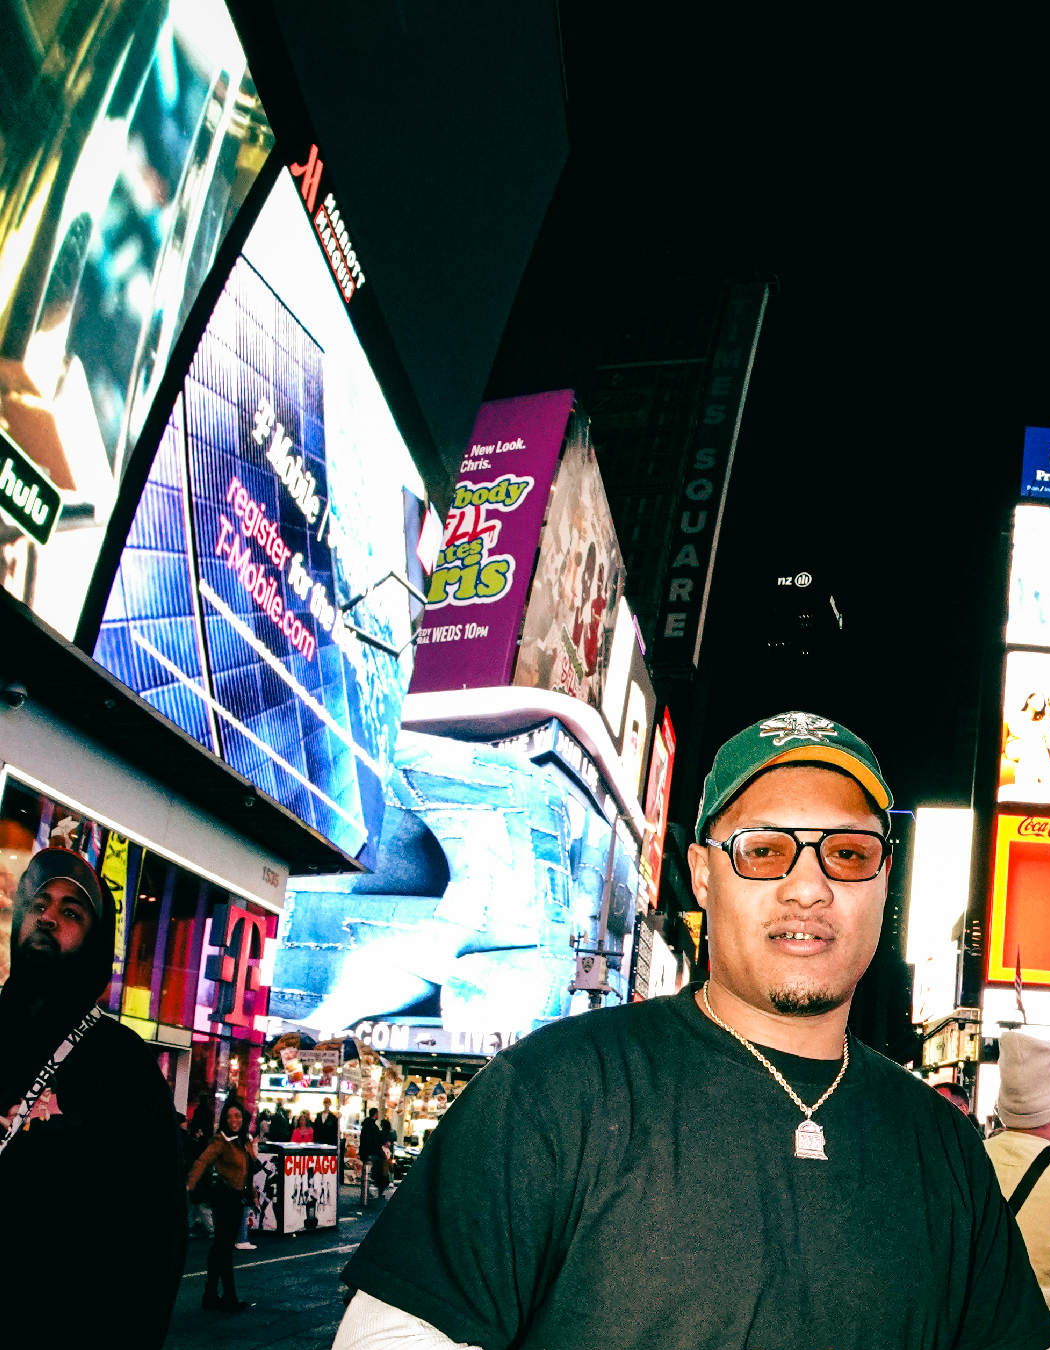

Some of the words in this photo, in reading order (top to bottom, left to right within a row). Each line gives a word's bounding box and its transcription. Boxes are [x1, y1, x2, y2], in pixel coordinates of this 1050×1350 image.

[316, 210, 353, 298] MARQUIS
[324, 193, 365, 289] MARRIOTT
[703, 293, 750, 426] TIMES
[460, 458, 492, 473] Chris.
[471, 443, 496, 458] New
[496, 437, 526, 454] Look.
[0, 458, 49, 526] hulu
[226, 476, 292, 571] register
[663, 448, 718, 638] SQUARE
[215, 515, 316, 662] T-Mobile.com
[432, 624, 463, 644] WEDS
[464, 622, 490, 640] 10PM
[66, 1010, 98, 1043] NEW
[284, 1155, 338, 1176] CHICAGO
